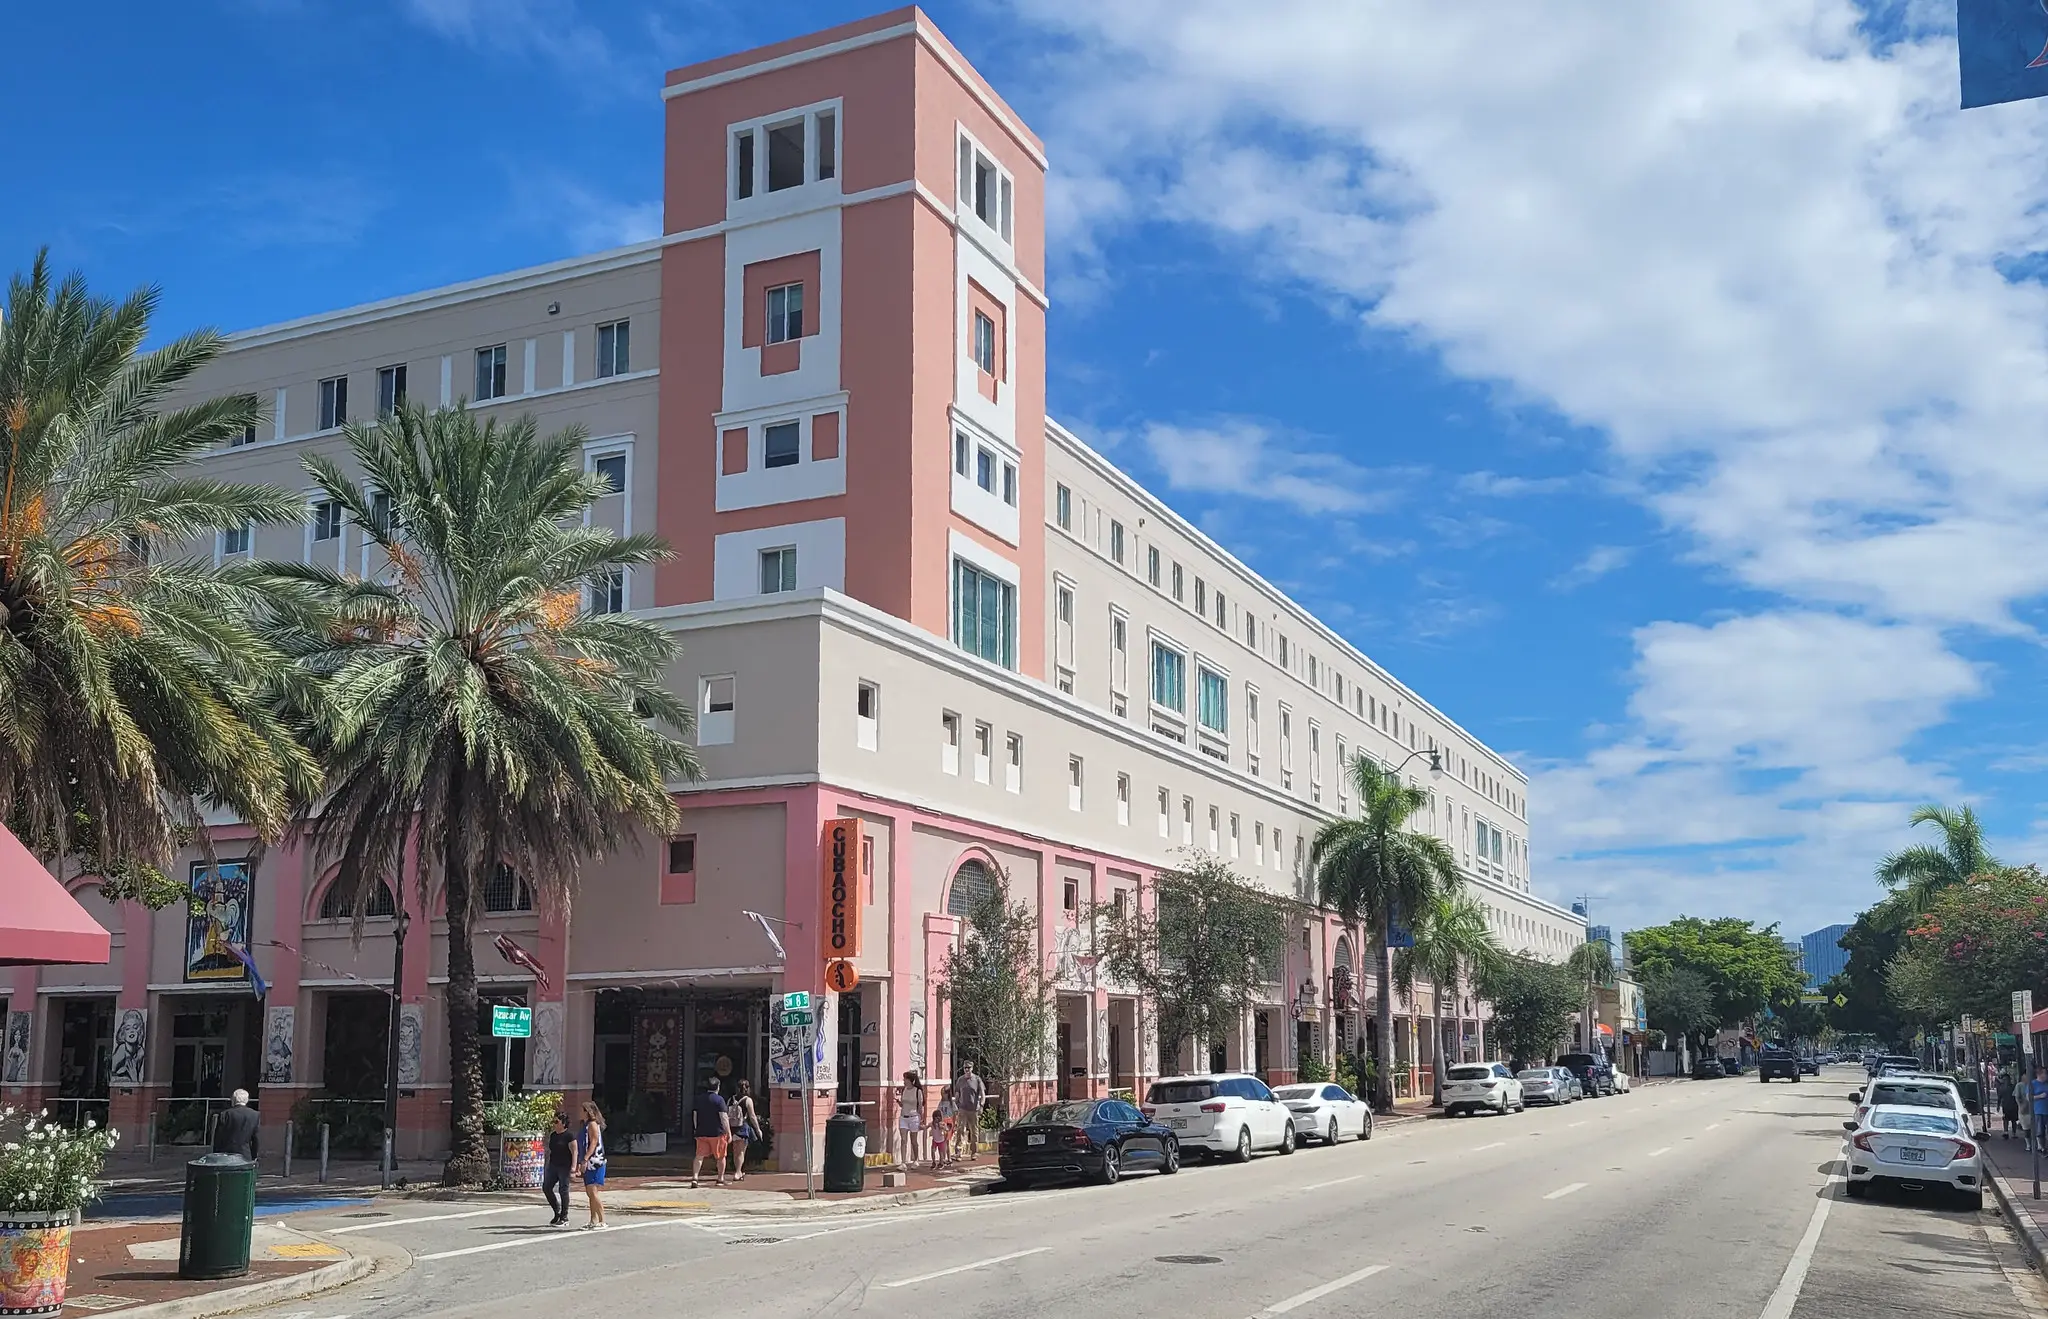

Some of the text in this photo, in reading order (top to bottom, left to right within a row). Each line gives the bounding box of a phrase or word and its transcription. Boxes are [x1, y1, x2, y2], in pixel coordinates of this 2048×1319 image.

[832, 827, 846, 949] CUBAOCHO
[796, 995, 801, 1007] 8
[495, 1009, 530, 1021] Azucar Av
[791, 1013, 800, 1025] 15
[804, 1014, 812, 1023] AV
